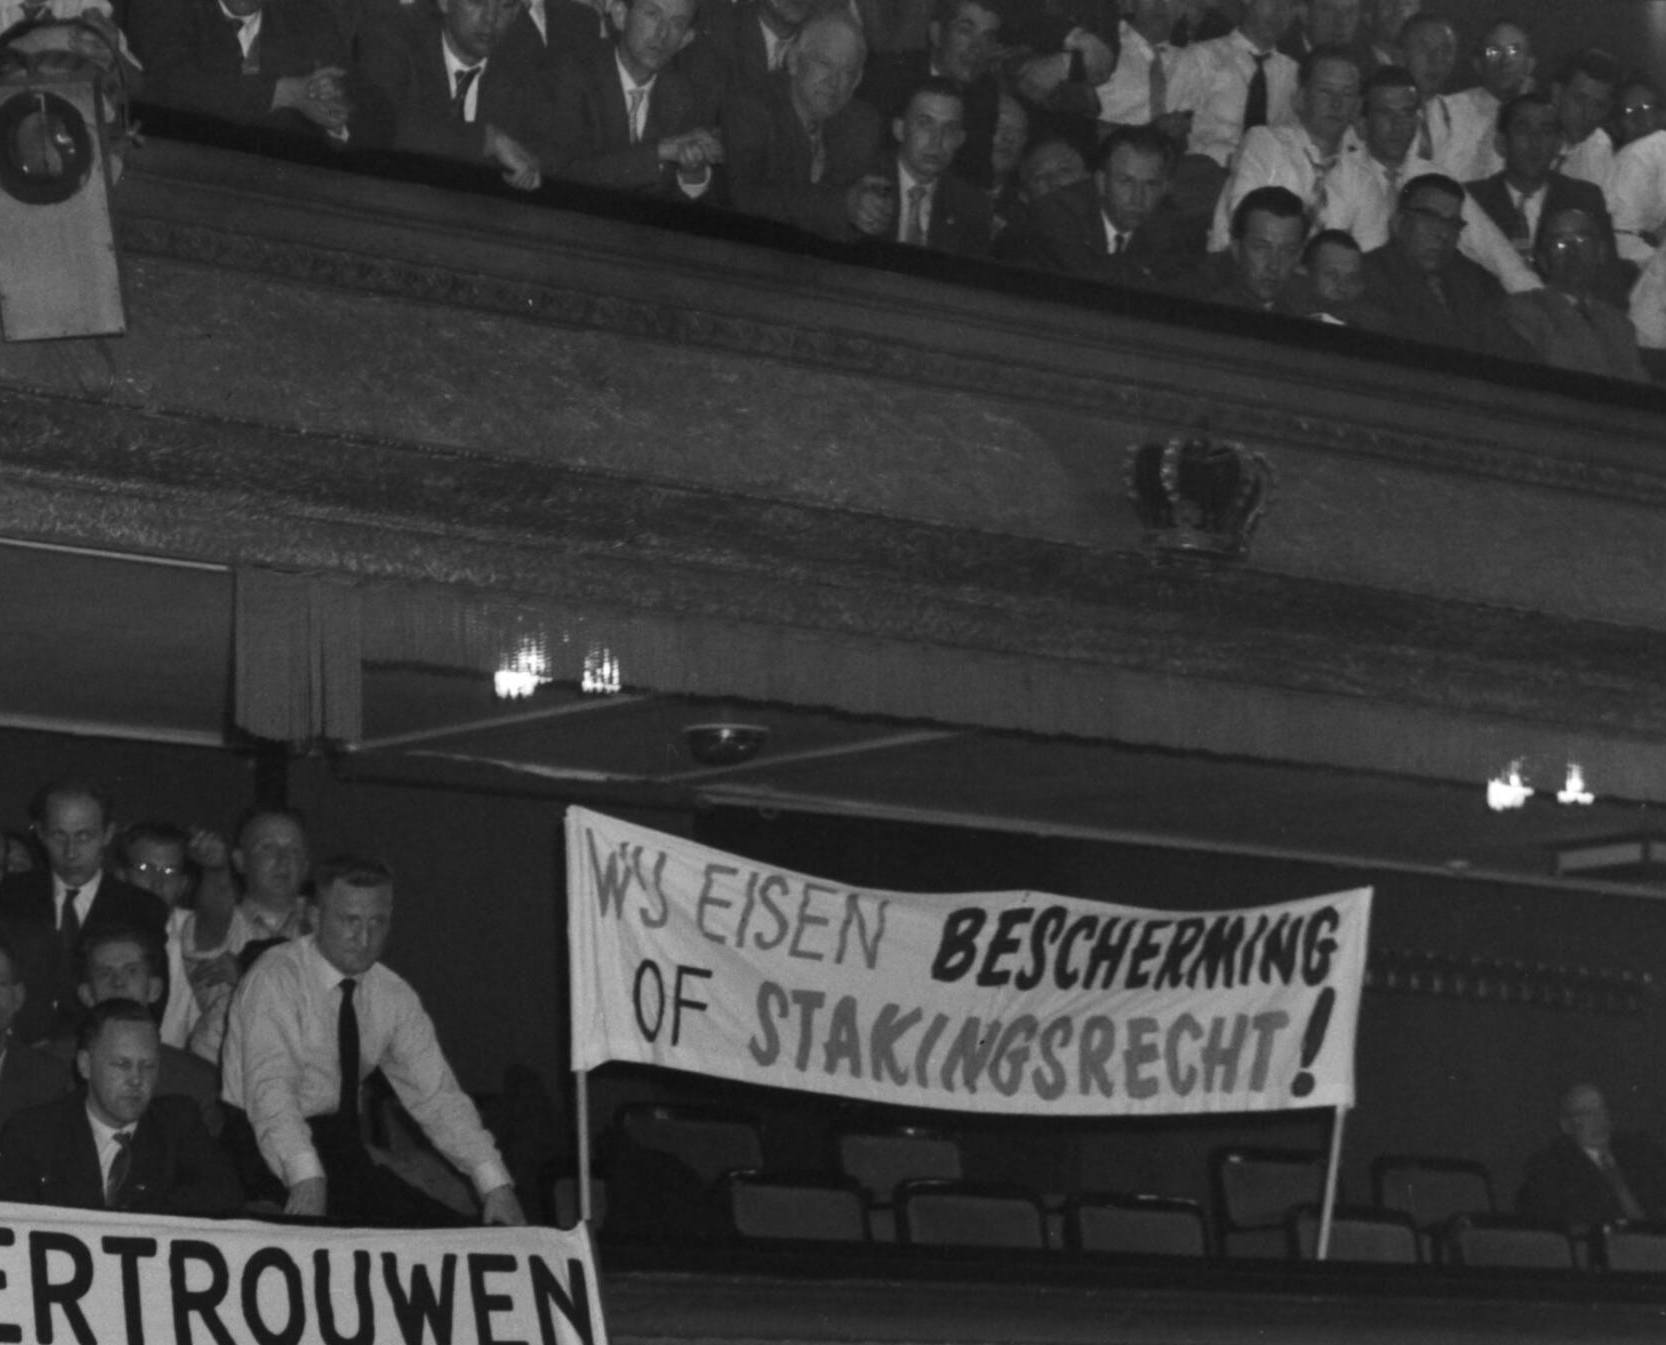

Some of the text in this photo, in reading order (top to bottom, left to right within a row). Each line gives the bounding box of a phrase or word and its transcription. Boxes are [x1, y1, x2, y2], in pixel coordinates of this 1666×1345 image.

[697, 863, 889, 971] EISEN
[932, 905, 1340, 992] BESCHERMING
[631, 958, 1337, 1102] OF STAKINGSRECHT!
